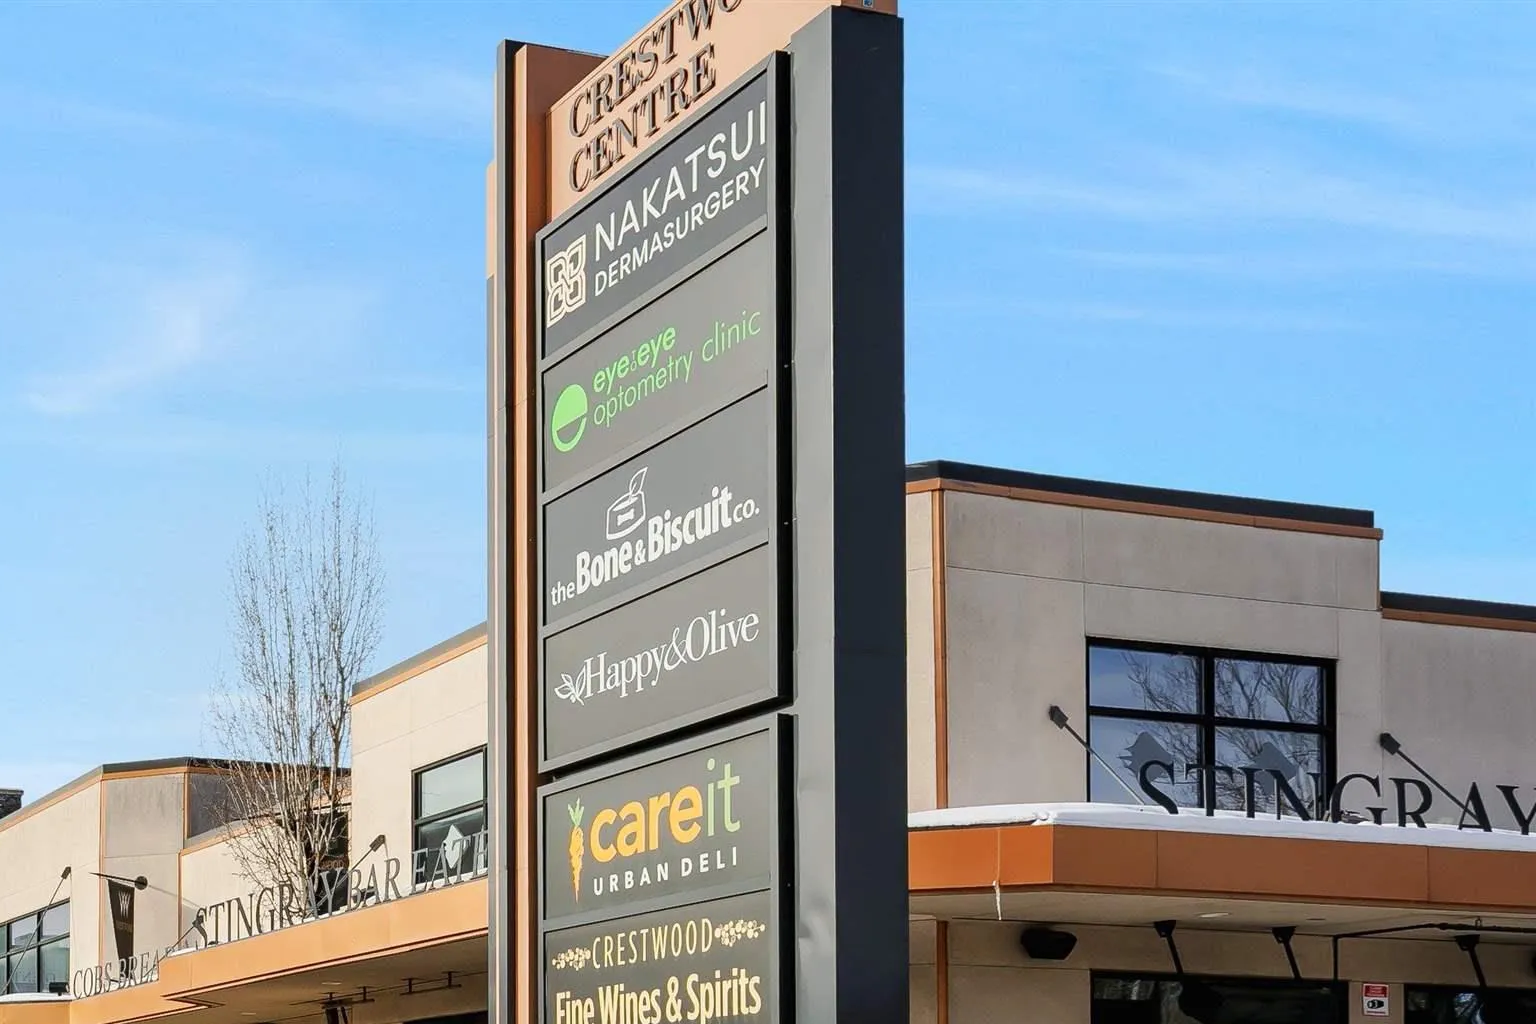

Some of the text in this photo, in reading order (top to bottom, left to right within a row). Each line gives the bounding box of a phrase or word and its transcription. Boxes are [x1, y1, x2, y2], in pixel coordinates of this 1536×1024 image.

[569, 0, 741, 138] CRESTW
[569, 44, 717, 192] CENTRE
[594, 101, 766, 262] NAKATSUI
[594, 157, 766, 297] DERMASURGERY
[593, 311, 761, 428] optometry clinic
[1138, 759, 1536, 836] STINGRAY
[347, 857, 401, 911] BAR
[593, 846, 738, 896] URBAN DELI
[74, 947, 168, 999] COBS BREA
[593, 918, 713, 969] CRESTWOOD
[665, 975, 682, 1024] &
